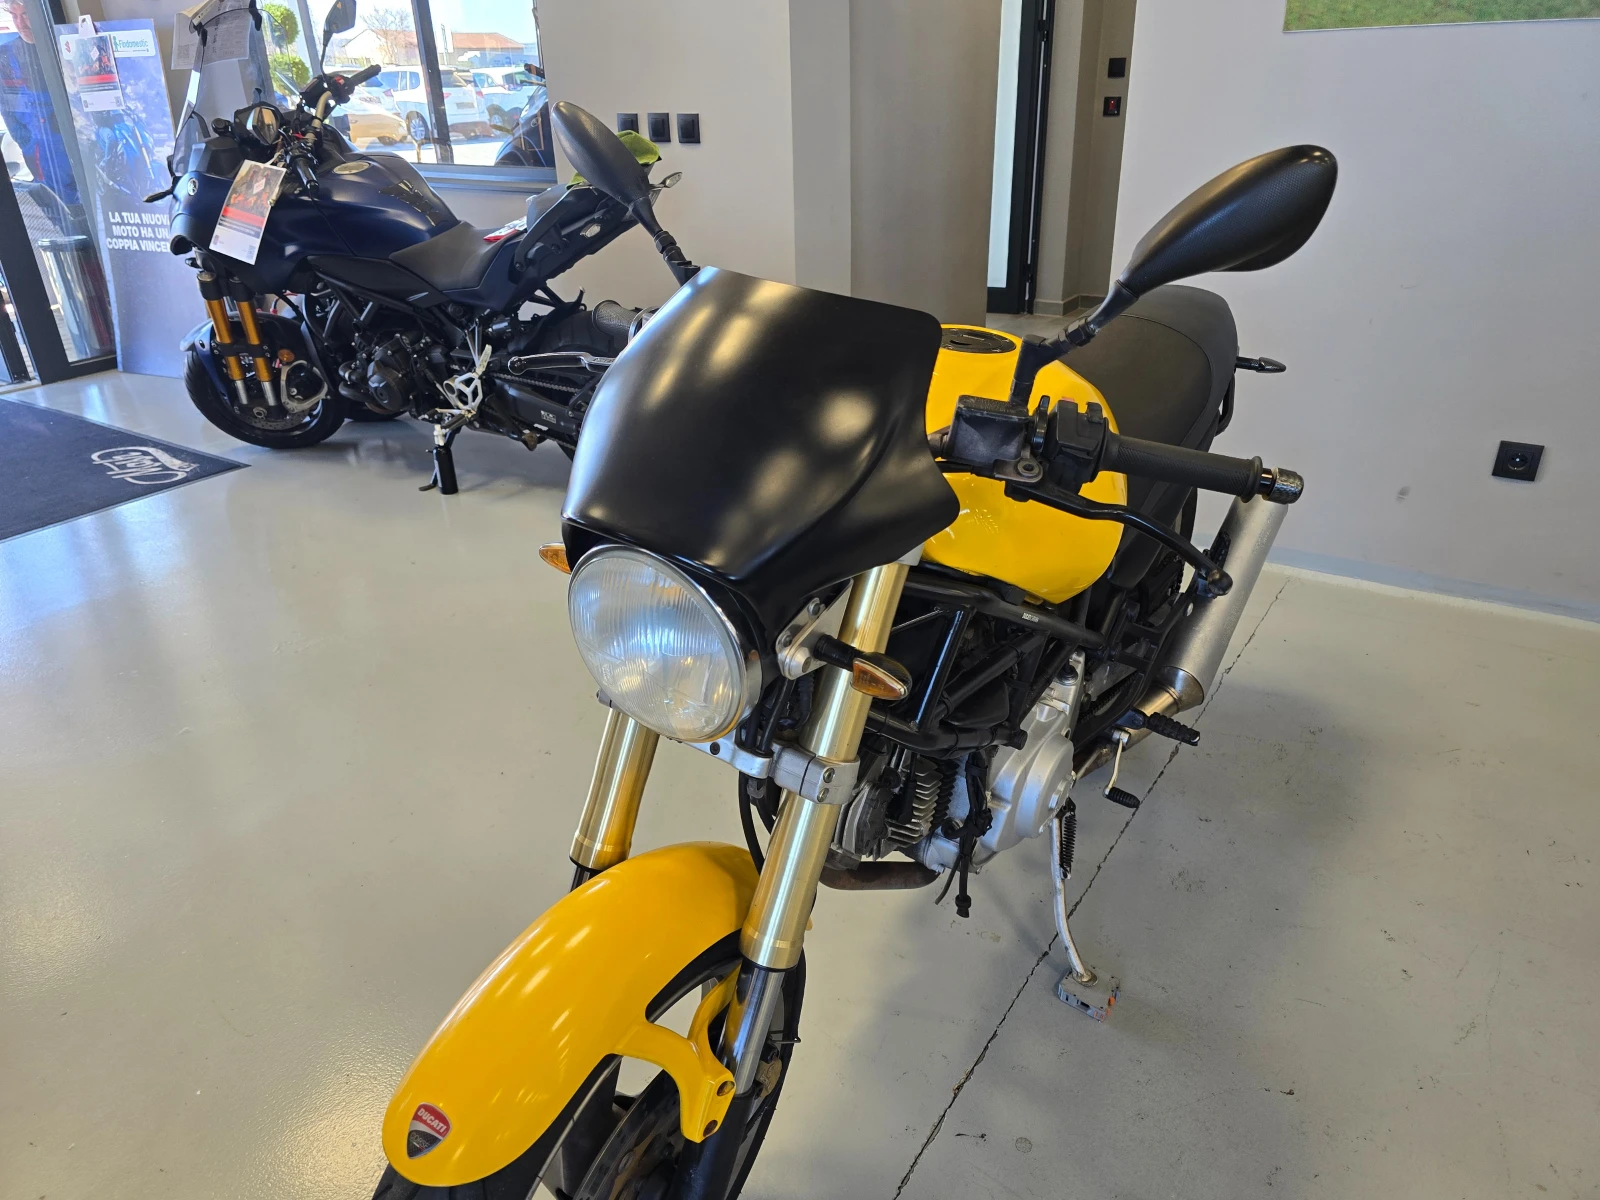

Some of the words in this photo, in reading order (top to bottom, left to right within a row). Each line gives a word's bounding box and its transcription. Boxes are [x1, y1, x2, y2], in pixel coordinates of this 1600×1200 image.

[108, 212, 121, 223] LA
[121, 212, 142, 224] TUA
[112, 225, 139, 237] MOTO
[141, 227, 154, 239] HA
[154, 228, 170, 240] UN
[106, 238, 139, 250] COPPIA
[417, 1107, 447, 1133] DUCATI
